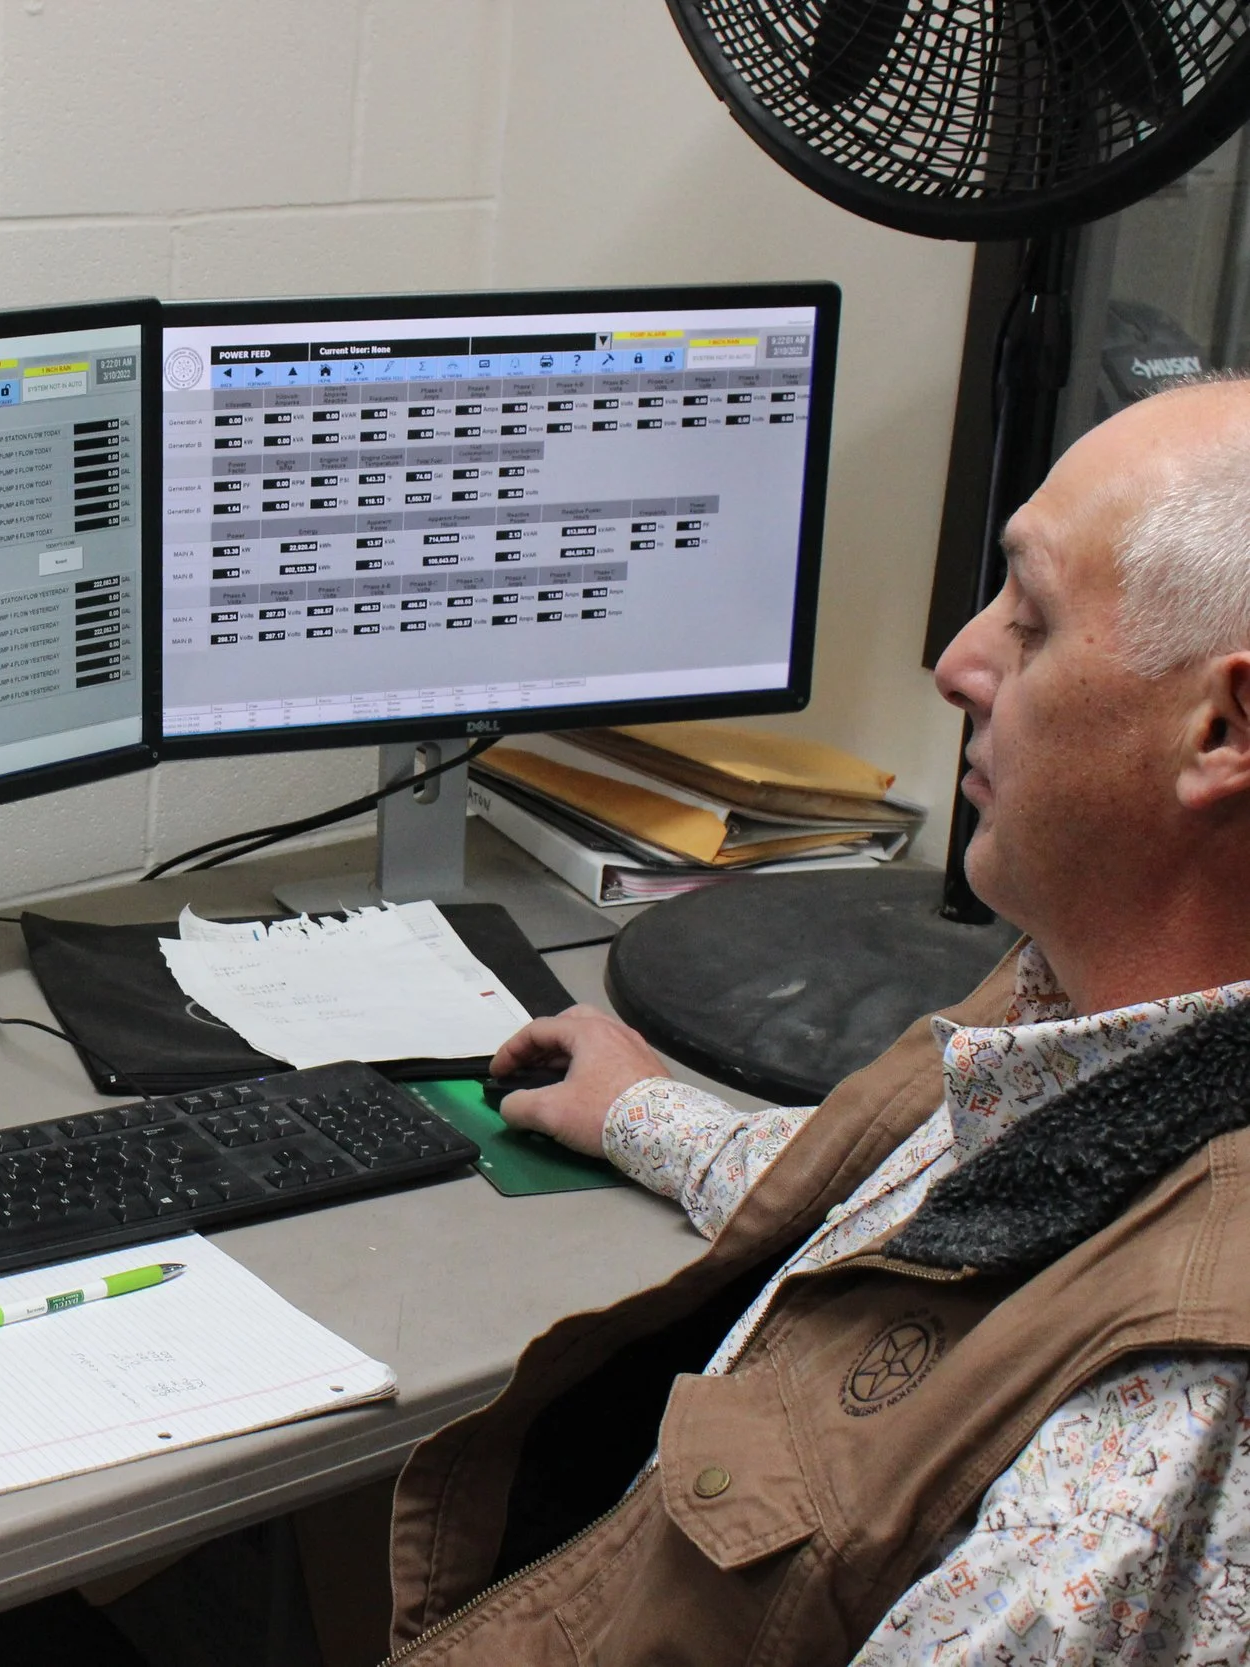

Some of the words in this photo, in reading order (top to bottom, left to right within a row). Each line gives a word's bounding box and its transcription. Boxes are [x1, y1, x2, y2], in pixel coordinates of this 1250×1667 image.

[219, 351, 249, 360] POWER
[251, 350, 270, 358] FEED
[320, 346, 348, 355] Current
[350, 346, 370, 354] User:
[100, 360, 122, 369] 9:22:01
[123, 358, 132, 366] AM
[1146, 356, 1202, 376] HUSKY
[103, 370, 131, 380] 3/10/2022
[28, 384, 48, 392] SYSTEM
[68, 380, 82, 388] AUTO
[4, 434, 27, 442] STATION
[44, 430, 61, 438] TODAY
[1, 596, 22, 604] STATION
[23, 593, 38, 601] FLOW
[39, 587, 69, 598] YESTERDAY
[466, 720, 501, 732] DELL
